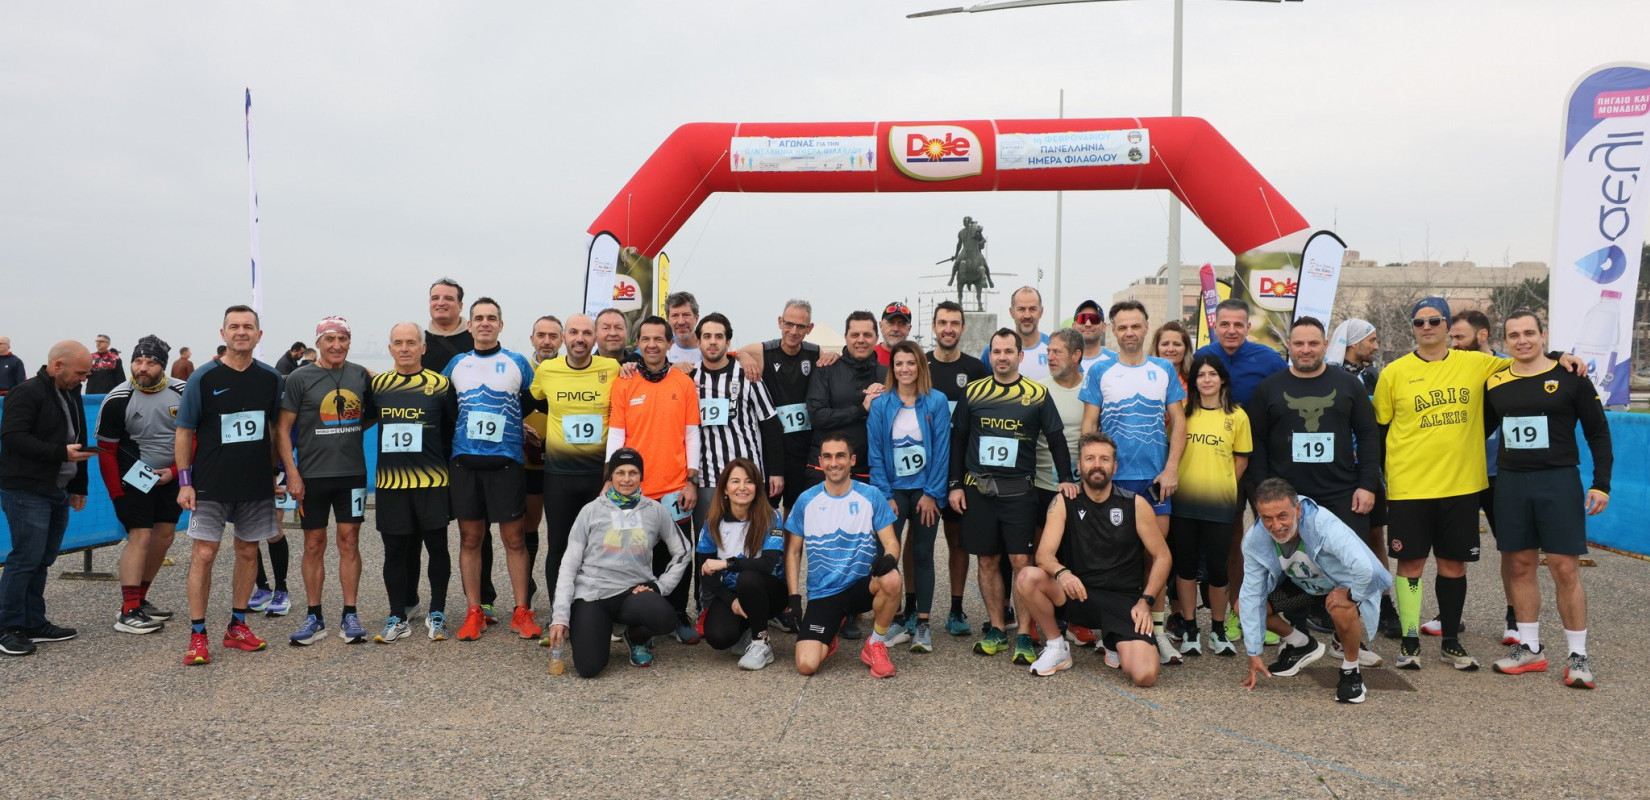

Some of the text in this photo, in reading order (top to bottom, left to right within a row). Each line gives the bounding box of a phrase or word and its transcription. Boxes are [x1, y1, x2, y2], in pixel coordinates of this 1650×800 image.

[1597, 94, 1650, 105] ΠΗΓΑΙΟ ΚΑΙ
[1598, 104, 1647, 114] ΜΟΝΑΔΙΚΟ
[906, 132, 970, 159] Dole
[1044, 133, 1111, 143] ΦΕΒΡΟΥΑΡΙΟΥ
[1040, 144, 1105, 154] ΠΑΝΕΛΛΗΝΙΑ
[1028, 153, 1118, 165] ΗΜΕΡΑ ΦΙΛΑΘΛΟΥ
[1415, 387, 1470, 412] ARIS
[700, 406, 720, 421] 19
[786, 411, 805, 427] 19
[1420, 410, 1468, 428] ALKIS
[232, 420, 257, 437] 19
[476, 420, 496, 436] 19
[572, 422, 594, 438] 19
[1511, 426, 1537, 443] 19
[391, 432, 413, 447] 19
[987, 445, 1009, 461] 19
[1302, 442, 1325, 458] 19
[901, 453, 924, 470] 19
